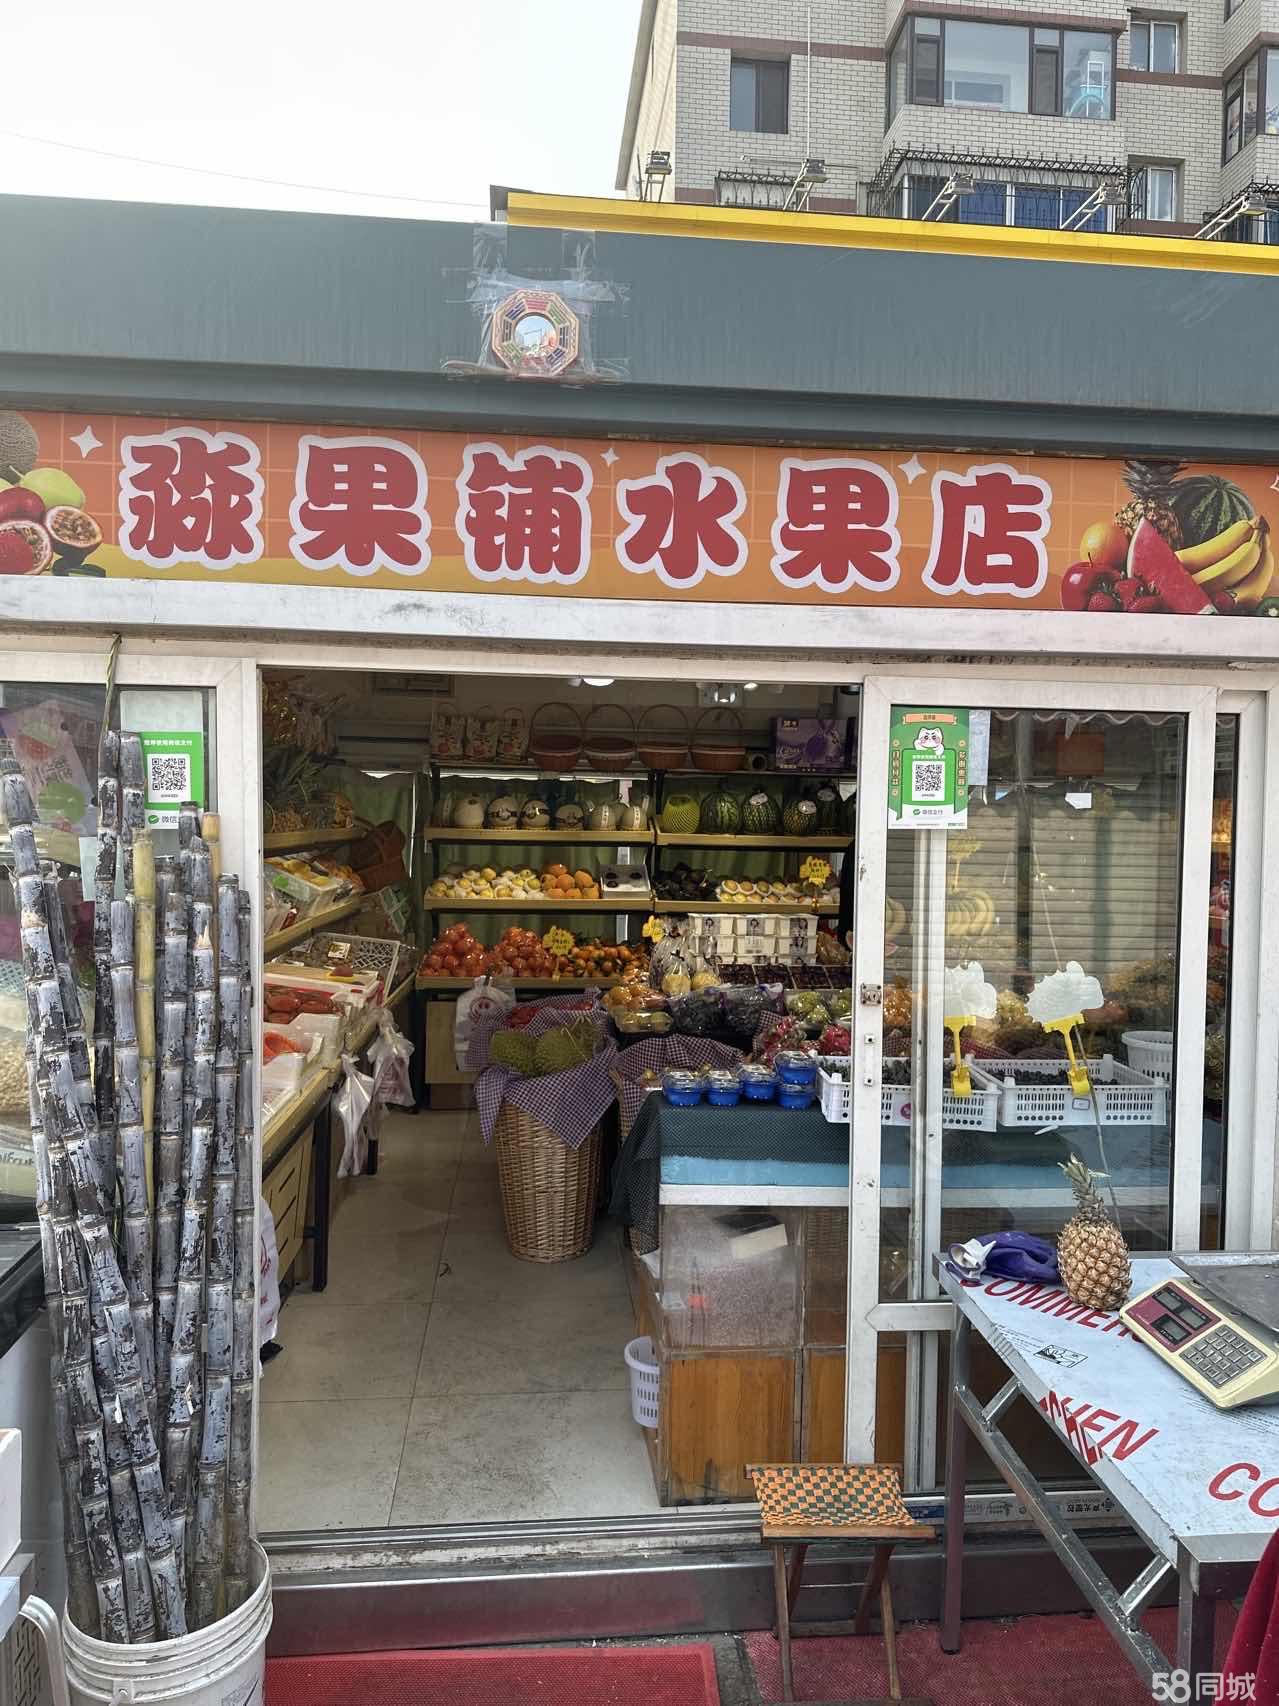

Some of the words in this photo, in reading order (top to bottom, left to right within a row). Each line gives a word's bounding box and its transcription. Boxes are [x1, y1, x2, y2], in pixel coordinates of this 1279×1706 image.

[121, 429, 1050, 596] 淼果铺水果店
[162, 815, 179, 823] 微信
